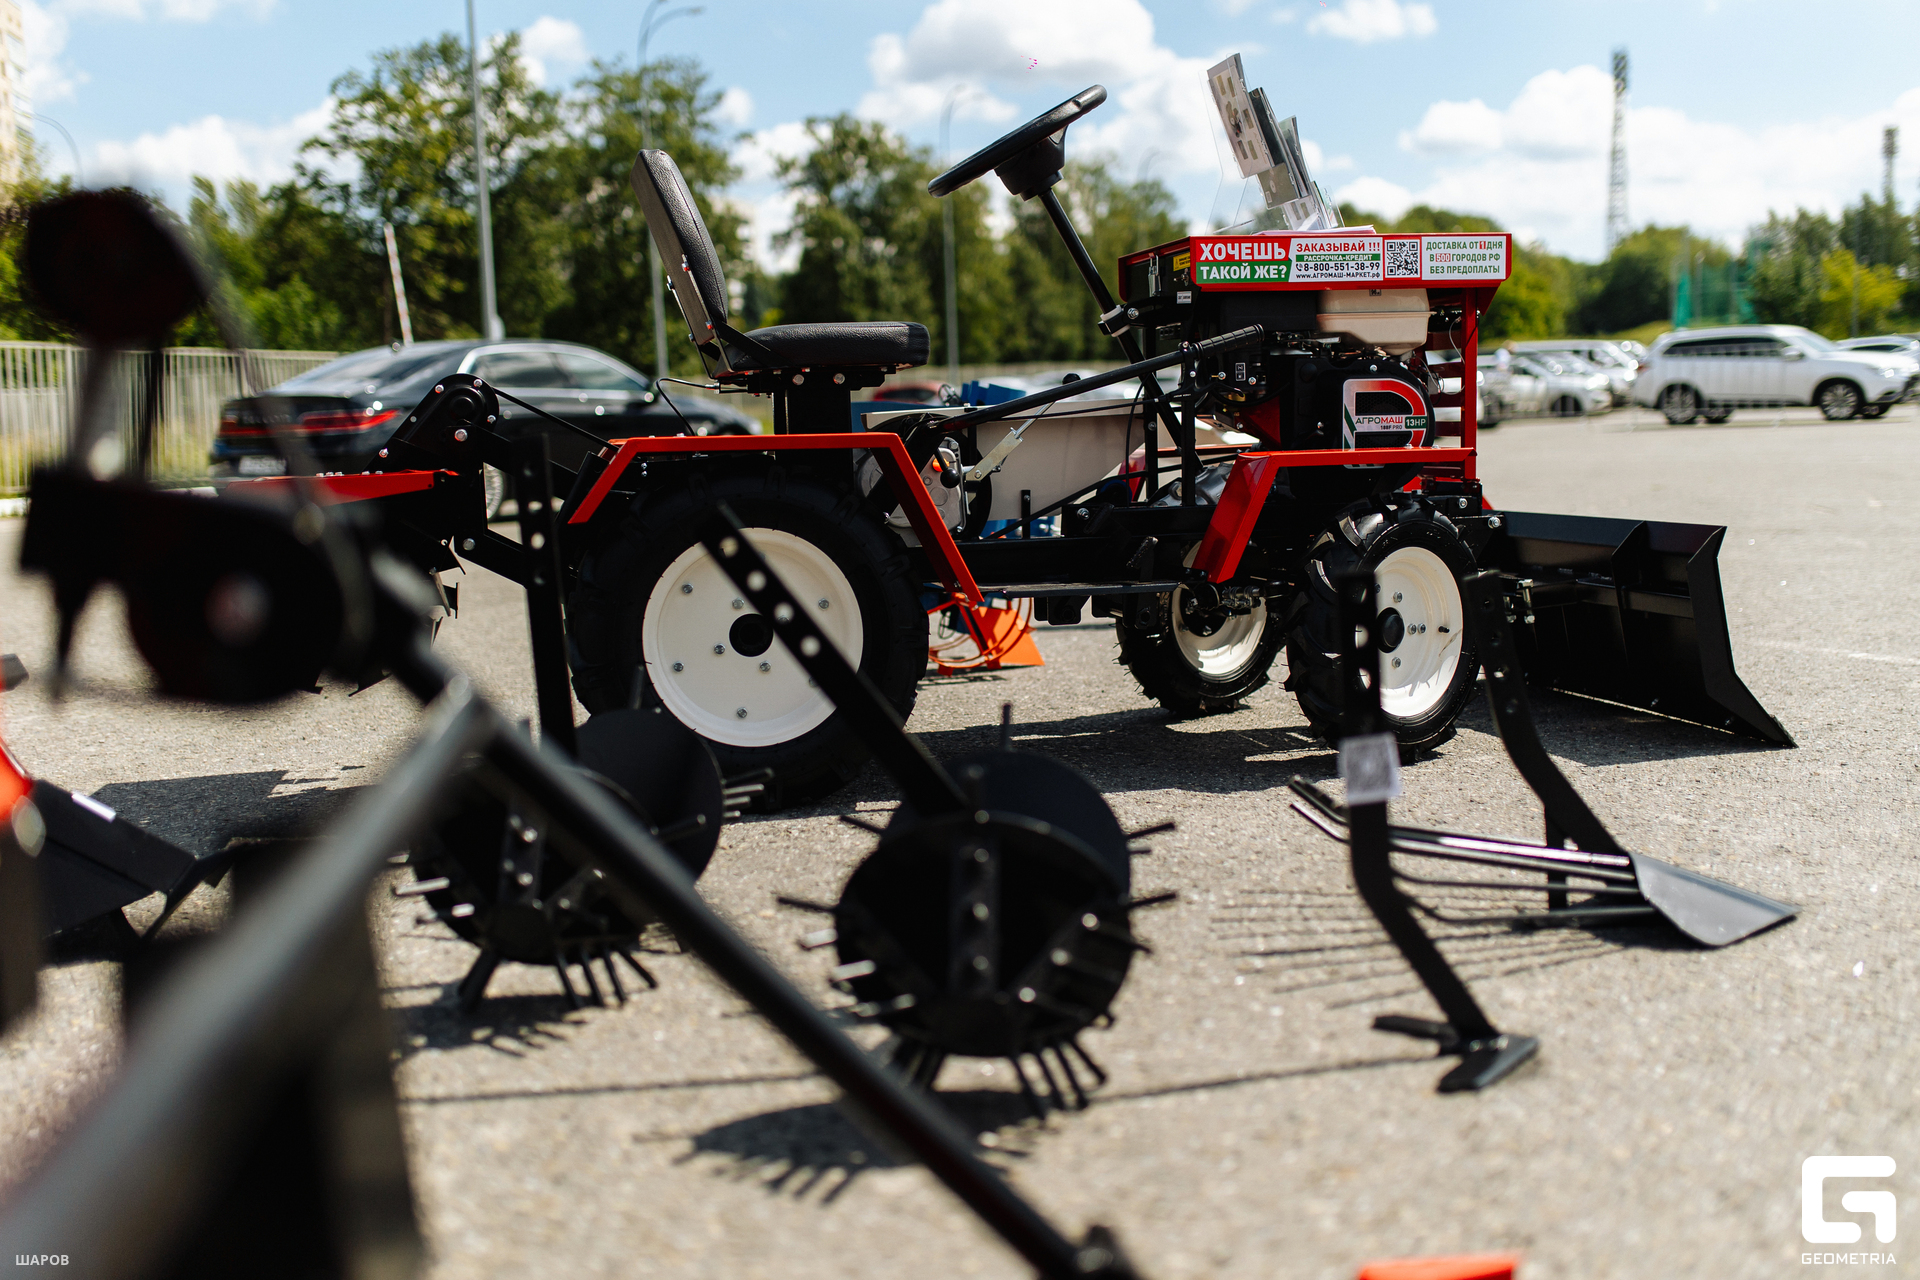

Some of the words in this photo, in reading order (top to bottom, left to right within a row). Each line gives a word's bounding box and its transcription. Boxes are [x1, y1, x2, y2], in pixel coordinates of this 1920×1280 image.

[1296, 240, 1365, 252] ЗАКАЗЫВАЙ
[1368, 242, 1380, 252] !!!
[1426, 241, 1467, 251] ДОСТАВКА
[1469, 241, 1479, 250] ОТ
[1486, 241, 1503, 251] ДНЯ
[1200, 243, 1286, 260] ХОЧЕШЬ
[1303, 254, 1372, 262] РАССРОЧКА-КРЕДИТ
[1429, 253, 1434, 262] В
[1436, 253, 1450, 262] 500
[1452, 253, 1487, 263] ГОРОДОВ
[1489, 253, 1500, 262] РФ
[1200, 263, 1250, 279] ТАКОЙ
[1254, 265, 1287, 279] ЖЕ?
[1303, 262, 1380, 272] 8-800-551-38-99
[1430, 265, 1445, 274] БЕЗ
[1447, 265, 1500, 275] ПРЕДОПЛАТЫ
[1355, 416, 1403, 424] АГРОМАШ
[1405, 418, 1426, 427] 13HP
